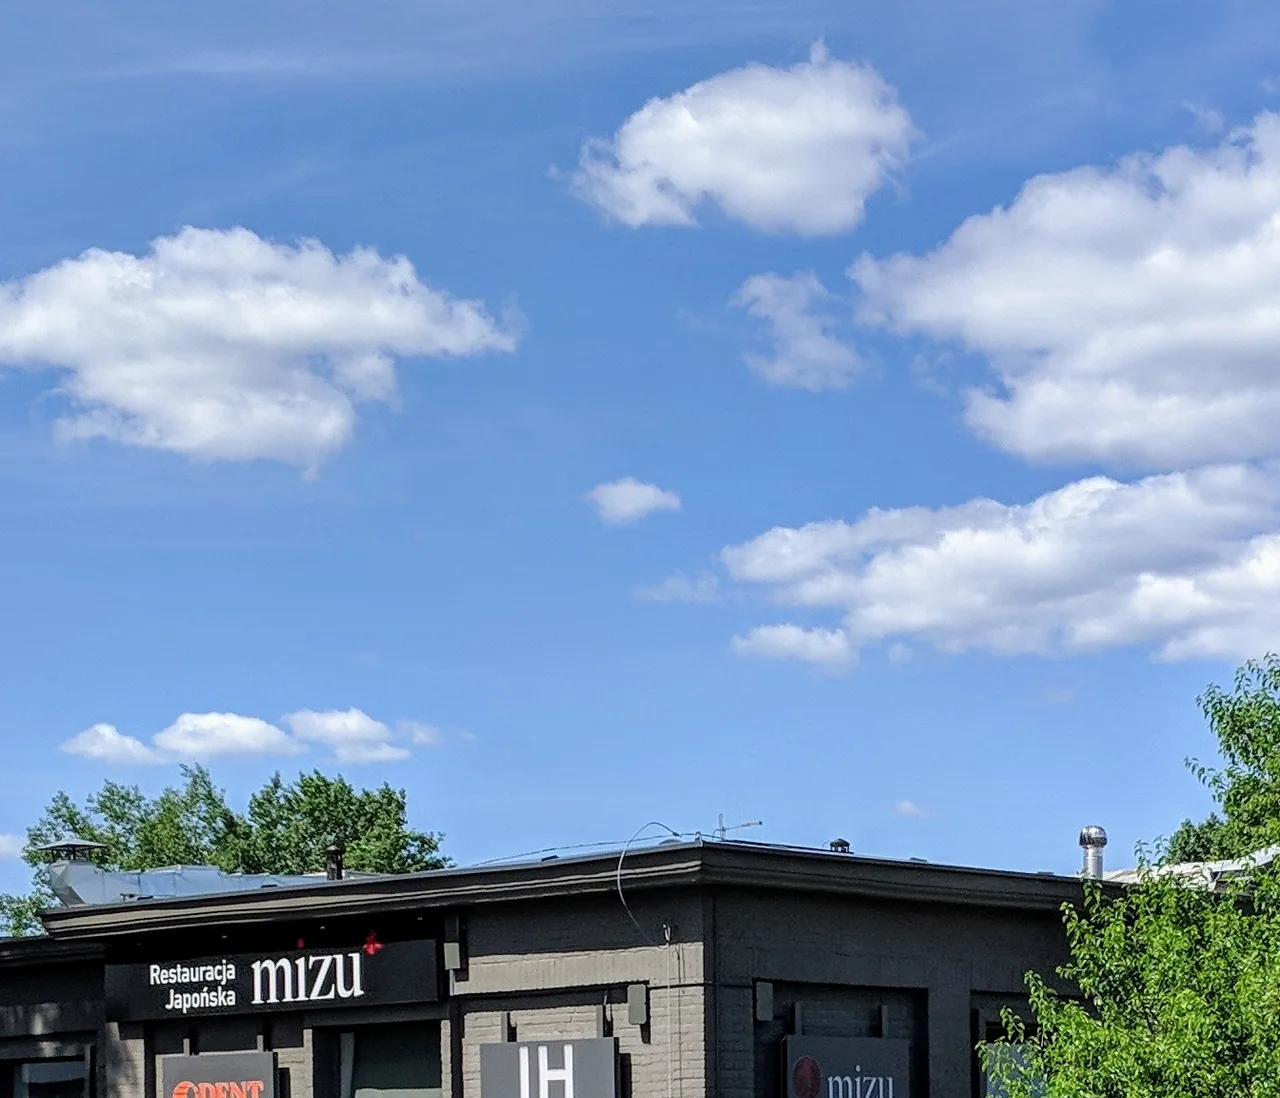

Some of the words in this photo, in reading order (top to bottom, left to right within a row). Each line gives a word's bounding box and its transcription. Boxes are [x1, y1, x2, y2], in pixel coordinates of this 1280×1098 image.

[149, 959, 236, 985] Restauracja
[250, 947, 365, 1004] mizu
[164, 986, 236, 1013] Japońska
